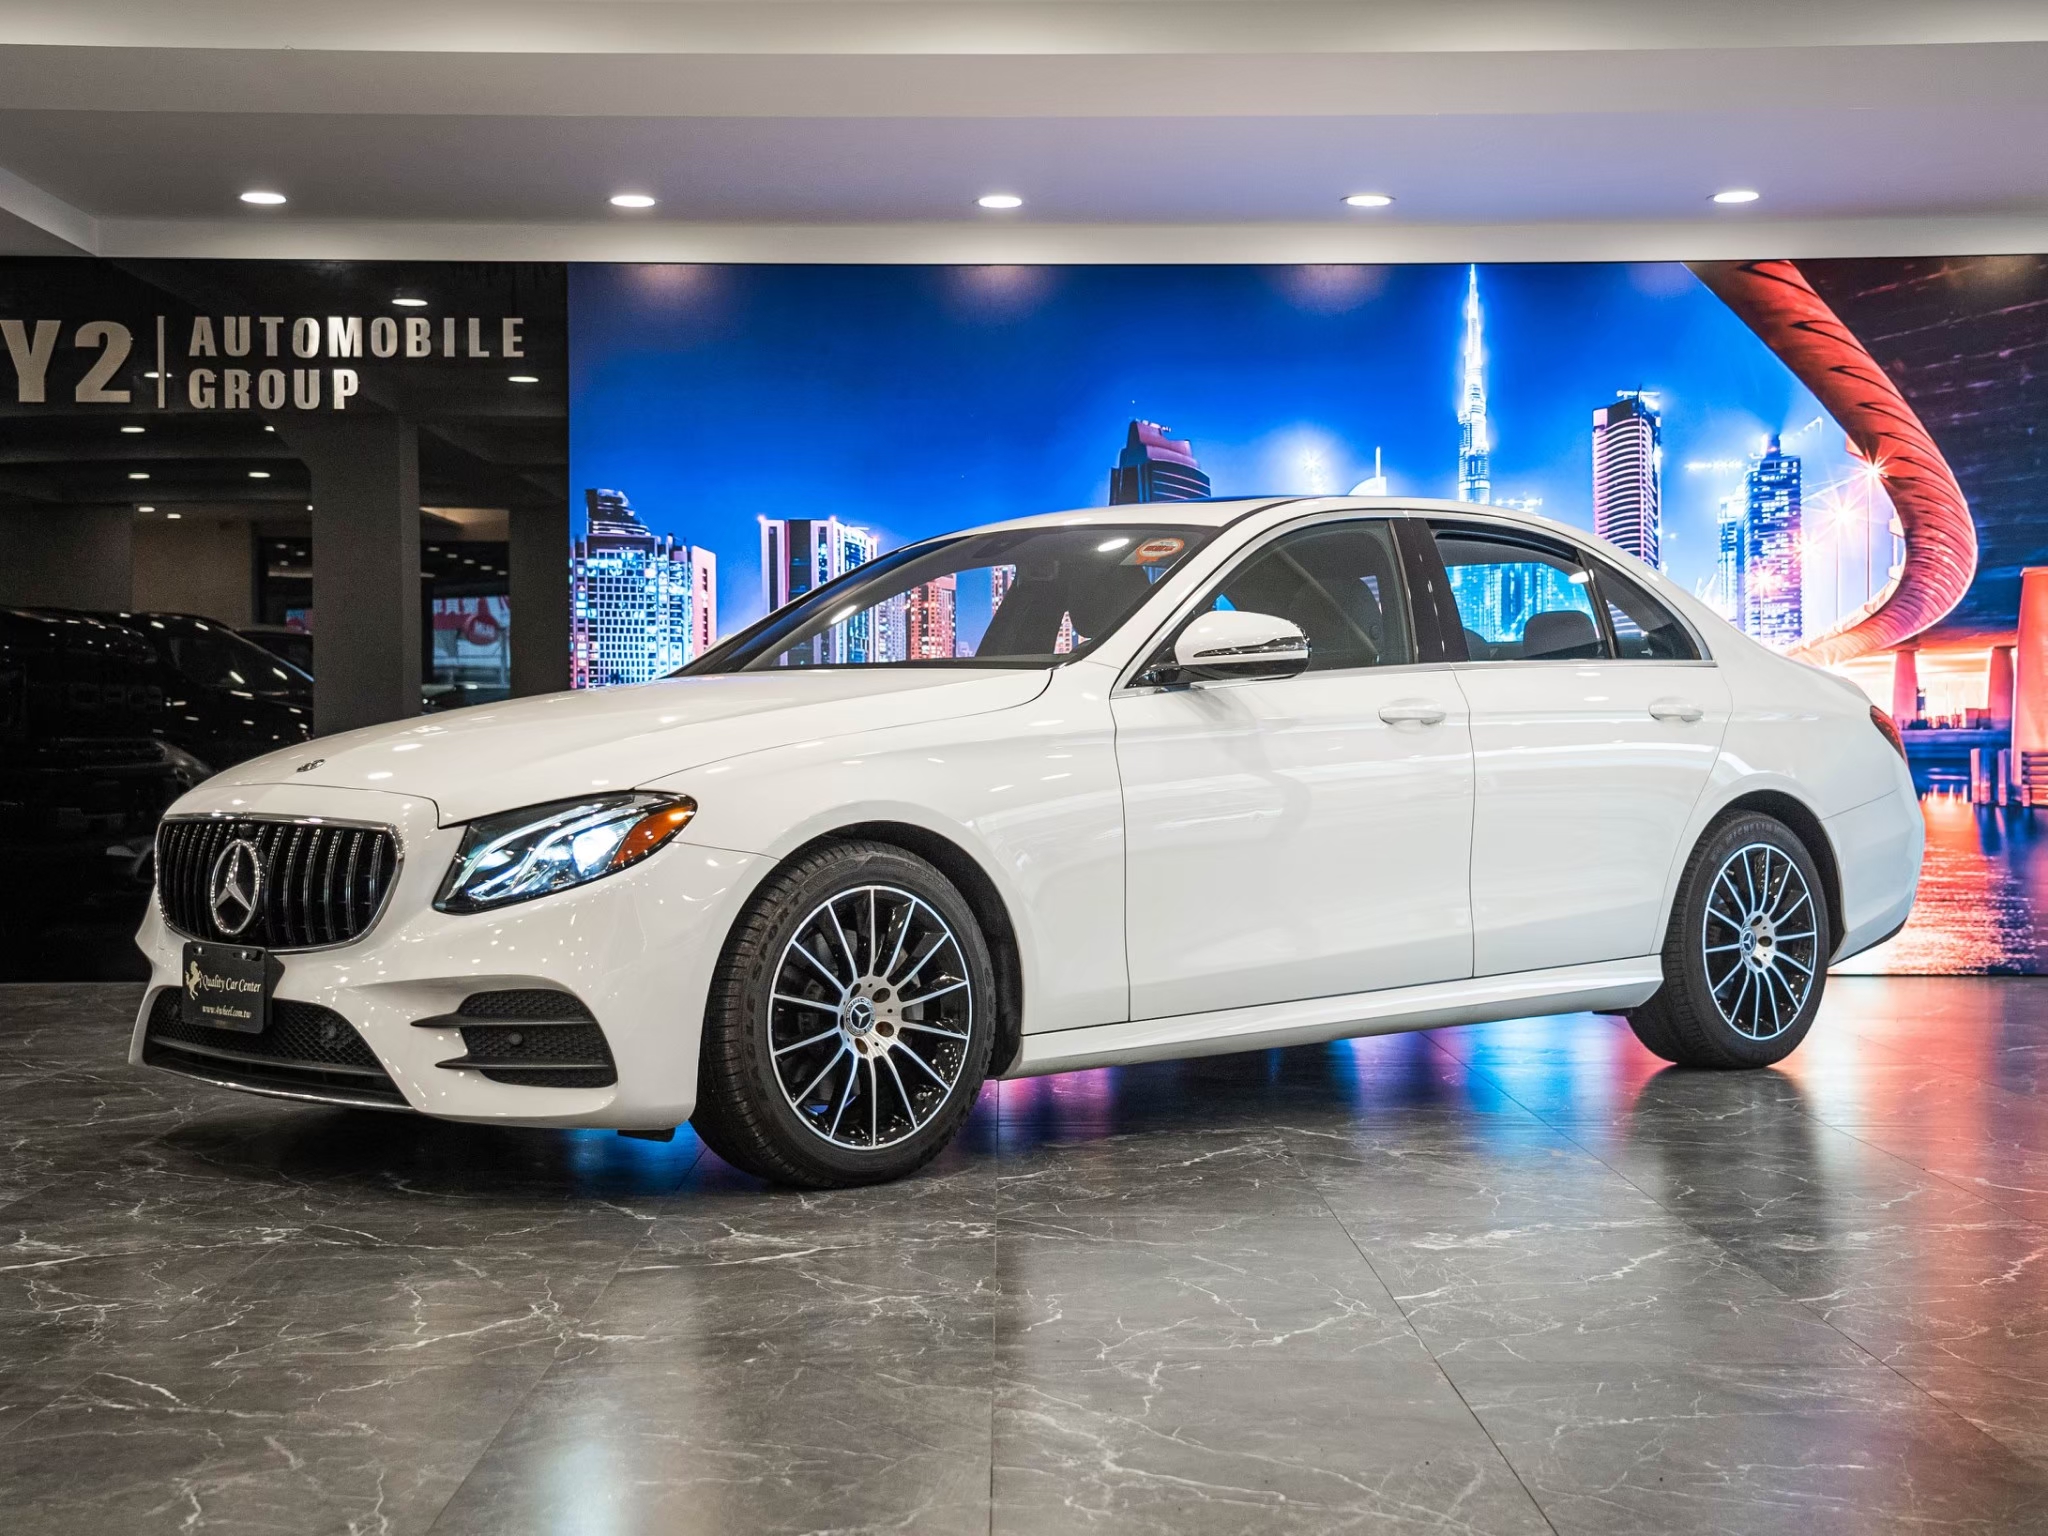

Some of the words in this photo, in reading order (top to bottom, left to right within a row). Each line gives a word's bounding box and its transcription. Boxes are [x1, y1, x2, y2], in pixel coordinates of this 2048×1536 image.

[189, 316, 525, 358] AUTOMOBILE
[0, 319, 132, 403] Y2
[189, 368, 360, 410] GROUP
[203, 974, 225, 992] Quality
[226, 977, 239, 991] Car
[239, 978, 261, 992] Center
